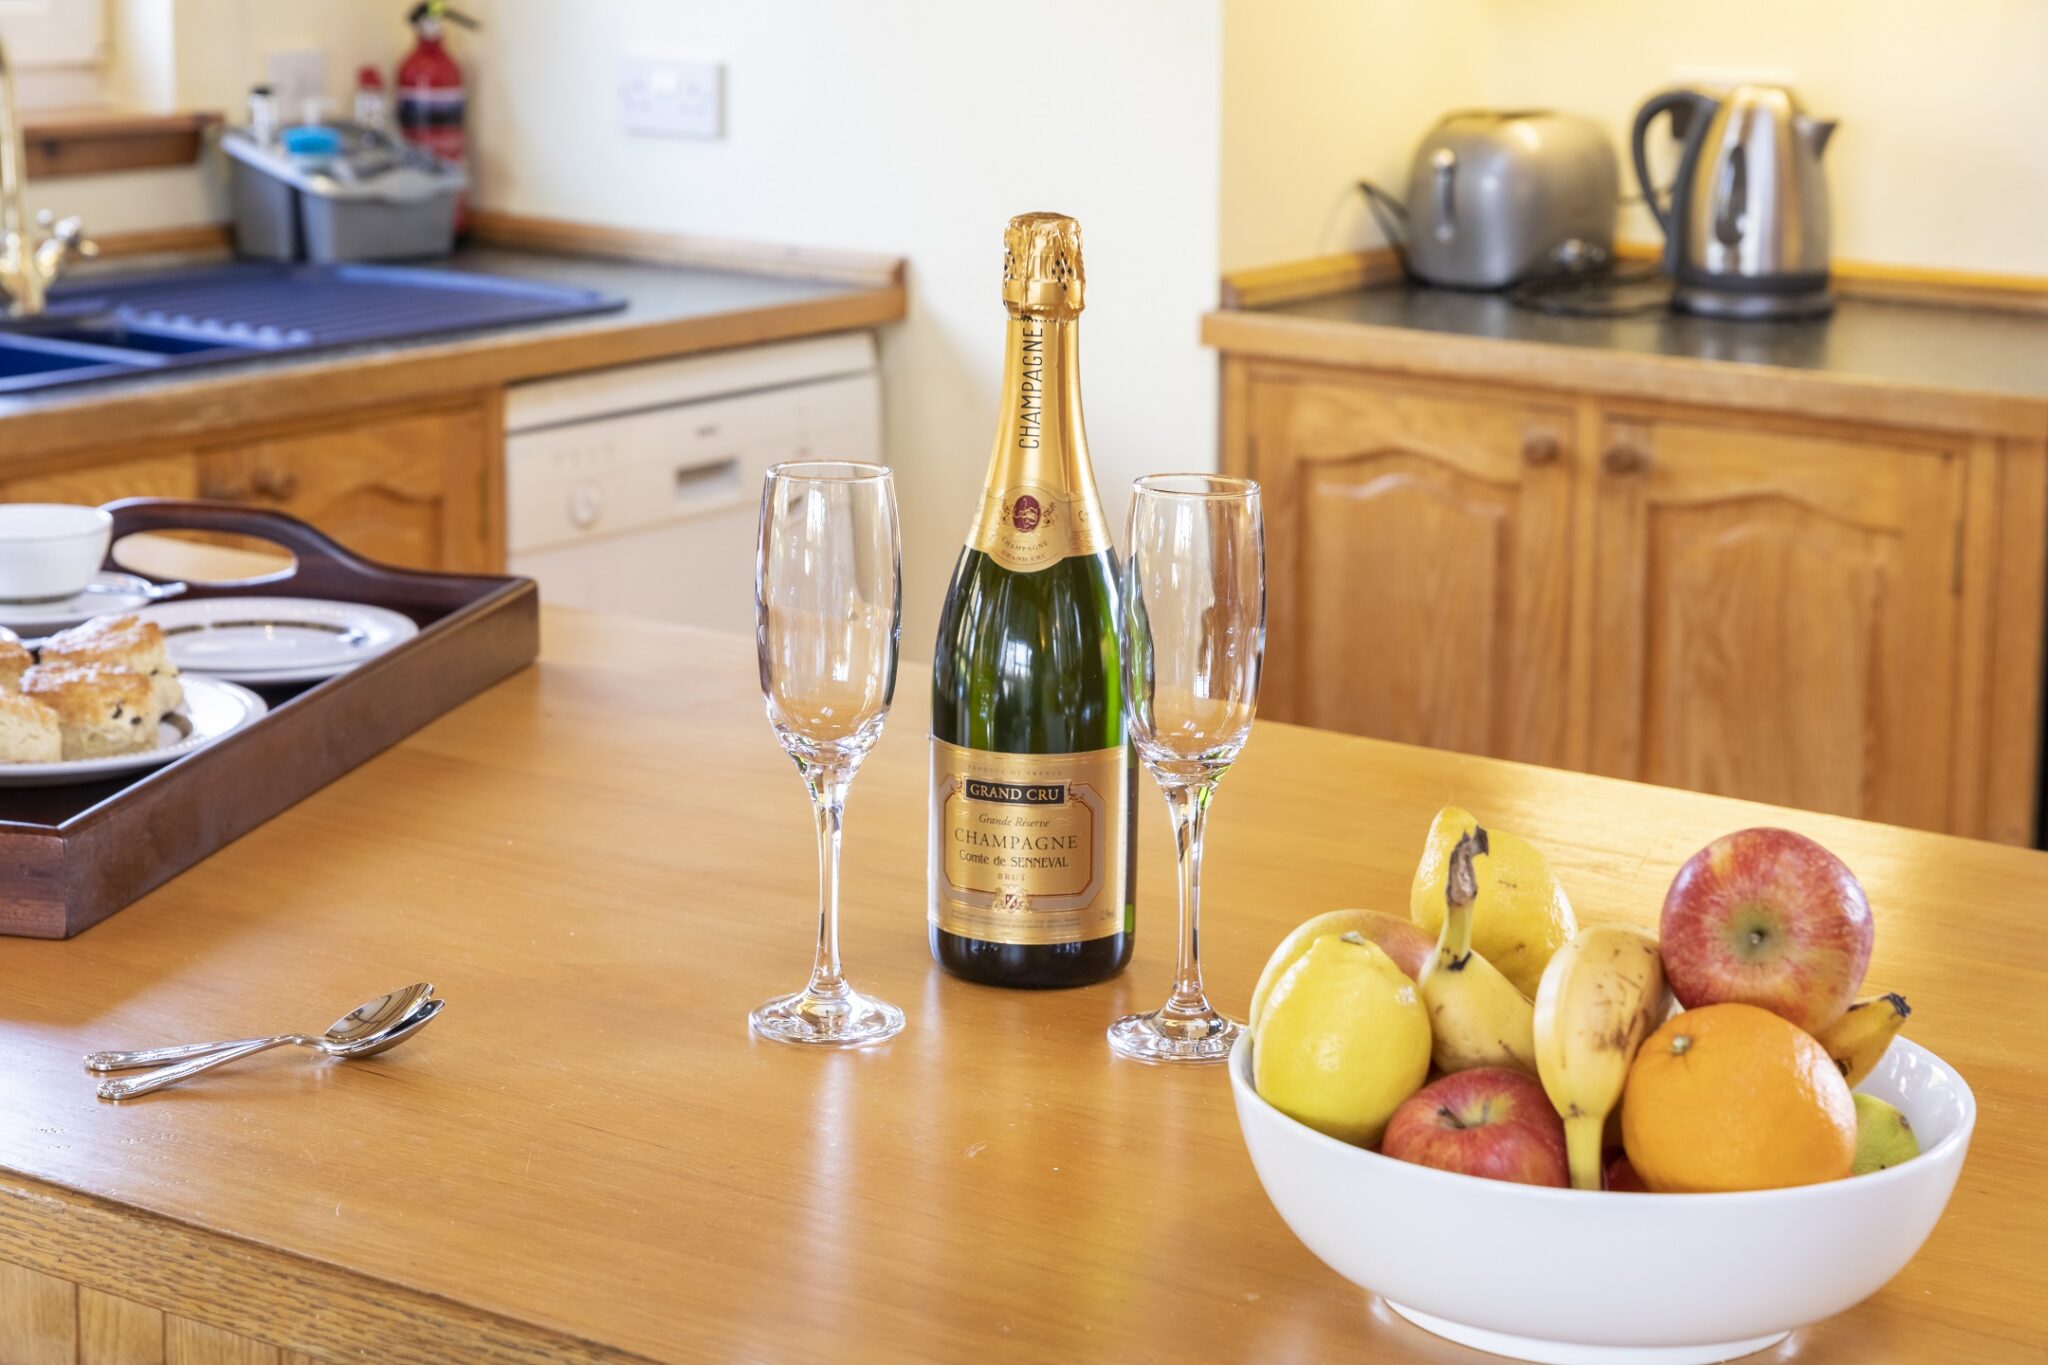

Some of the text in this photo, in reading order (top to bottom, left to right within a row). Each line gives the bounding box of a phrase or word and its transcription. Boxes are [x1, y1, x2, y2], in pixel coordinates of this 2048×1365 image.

[1018, 327, 1043, 449] CHAMPAGNE
[1001, 536, 1049, 552] CHAMPAGNE
[969, 783, 1060, 801] GRAND CRU
[978, 812, 1050, 828] Grande Réserve
[954, 828, 1078, 851] CHAMPAGNE
[959, 849, 1069, 869] Comte de SENNEVAL
